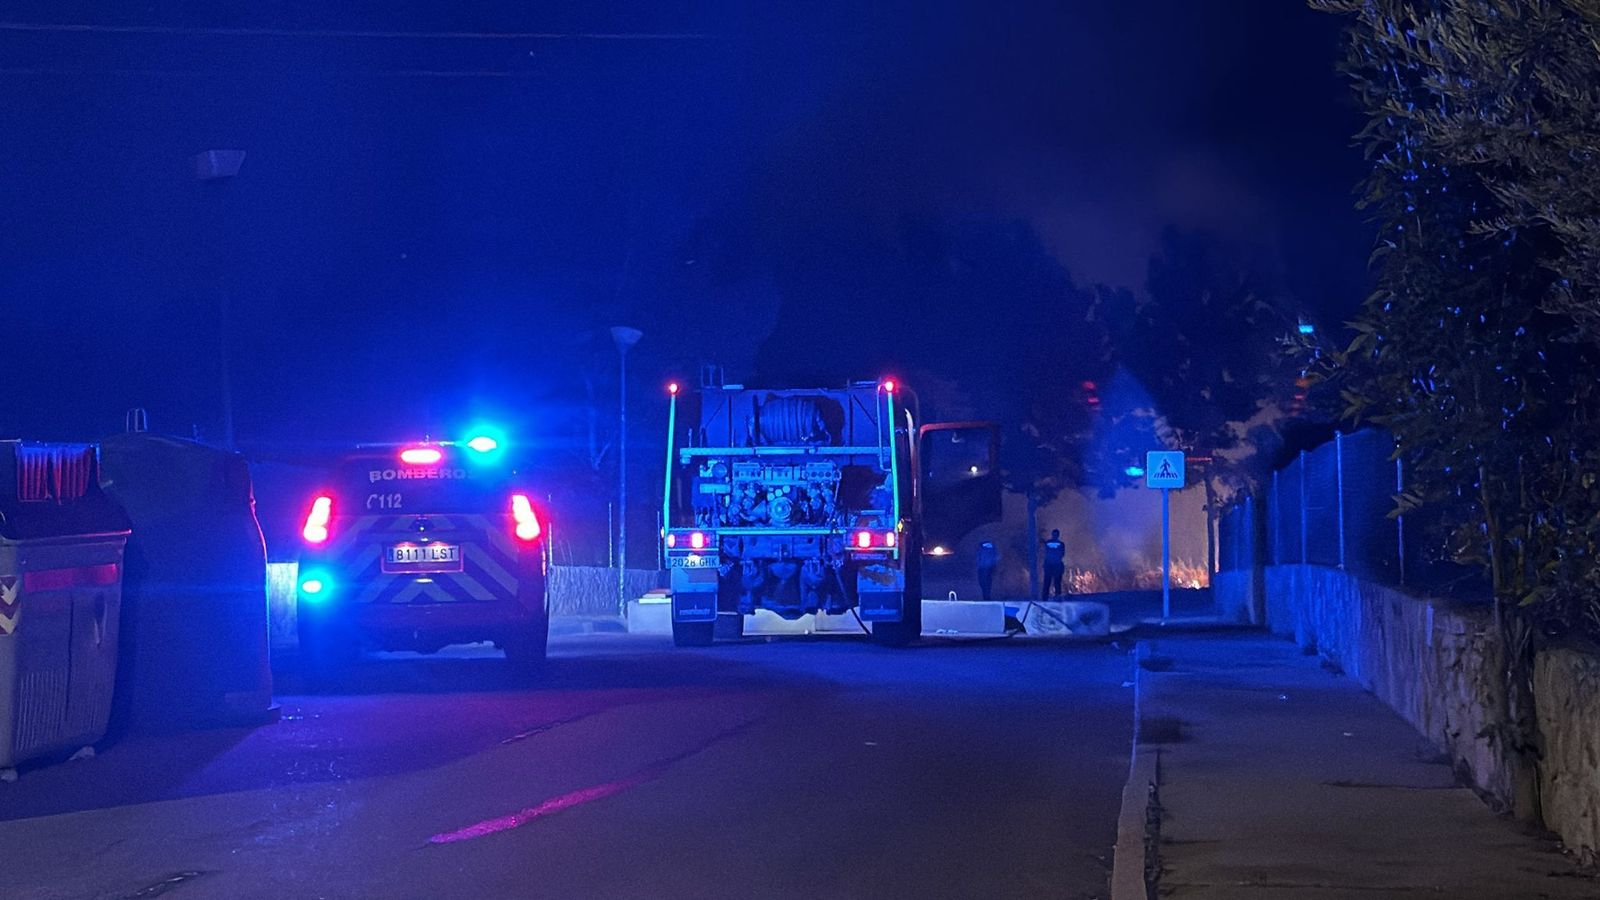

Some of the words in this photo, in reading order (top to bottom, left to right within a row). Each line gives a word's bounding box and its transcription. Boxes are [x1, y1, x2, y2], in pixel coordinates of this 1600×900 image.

[396, 548, 427, 561] 8111
[431, 547, 455, 560] LST
[699, 557, 717, 568] GHK
